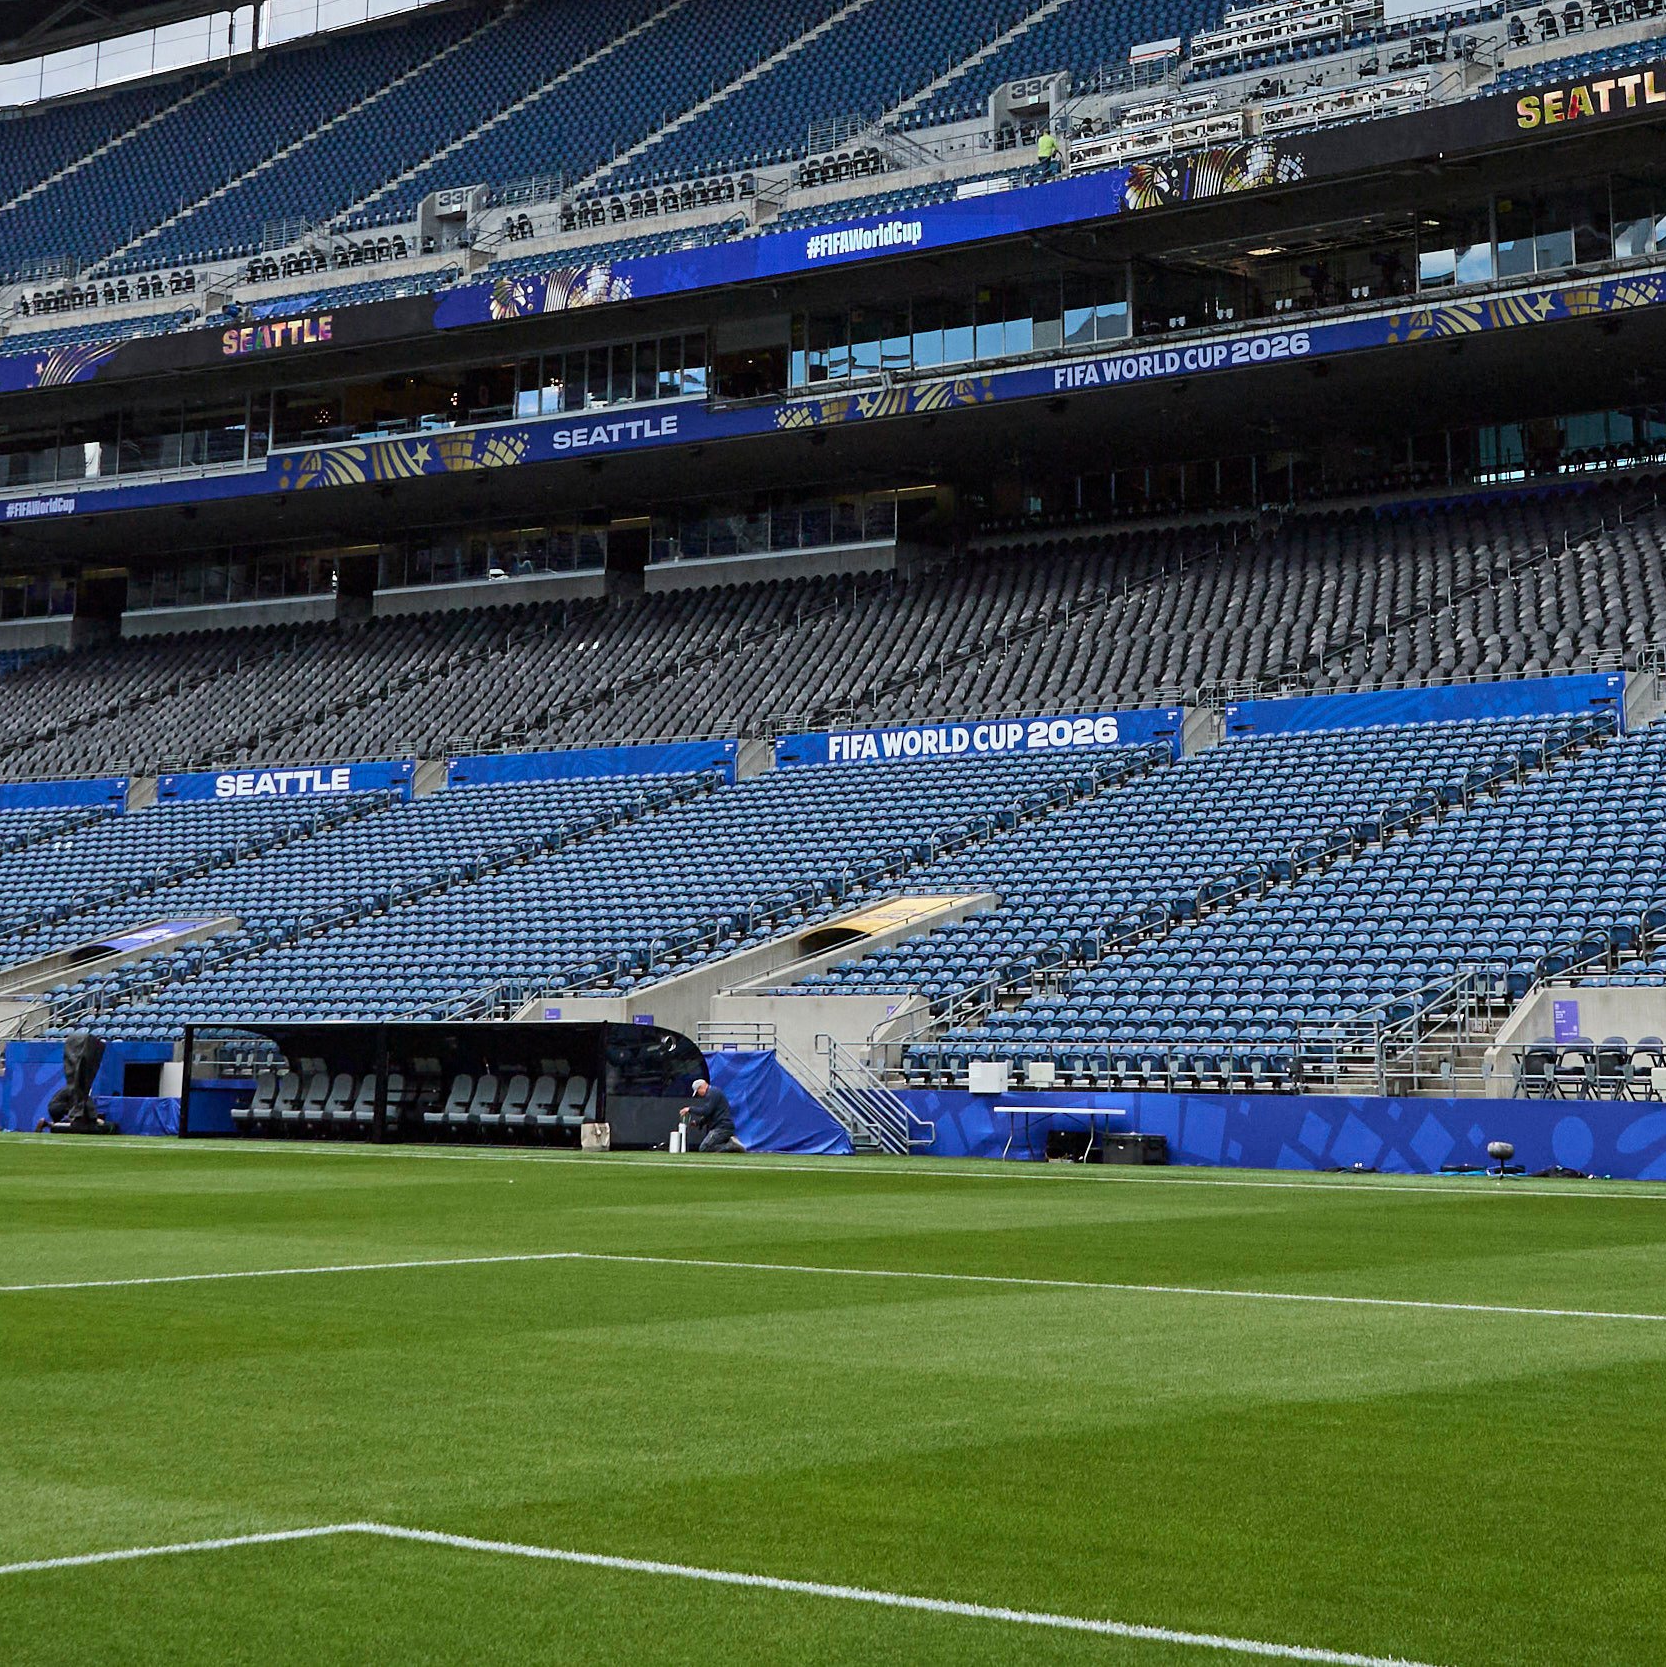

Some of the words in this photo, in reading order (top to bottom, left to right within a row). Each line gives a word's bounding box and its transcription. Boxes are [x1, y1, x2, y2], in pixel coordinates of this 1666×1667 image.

[807, 221, 922, 259] #FIFAWorldCup
[222, 315, 333, 355] SEATTLE
[1054, 368, 1100, 389] FIFA
[1102, 352, 1181, 382] WORLD
[1184, 345, 1228, 370] CUP
[1231, 332, 1310, 364] 2026
[553, 415, 678, 450] SEATTLE
[6, 497, 75, 518] #FIFAWorldCup
[828, 733, 878, 761] FIFA
[881, 727, 969, 756] WORLD
[973, 723, 1024, 750] CUP
[1027, 717, 1118, 748] 2026
[215, 768, 350, 797] SEATTLE
